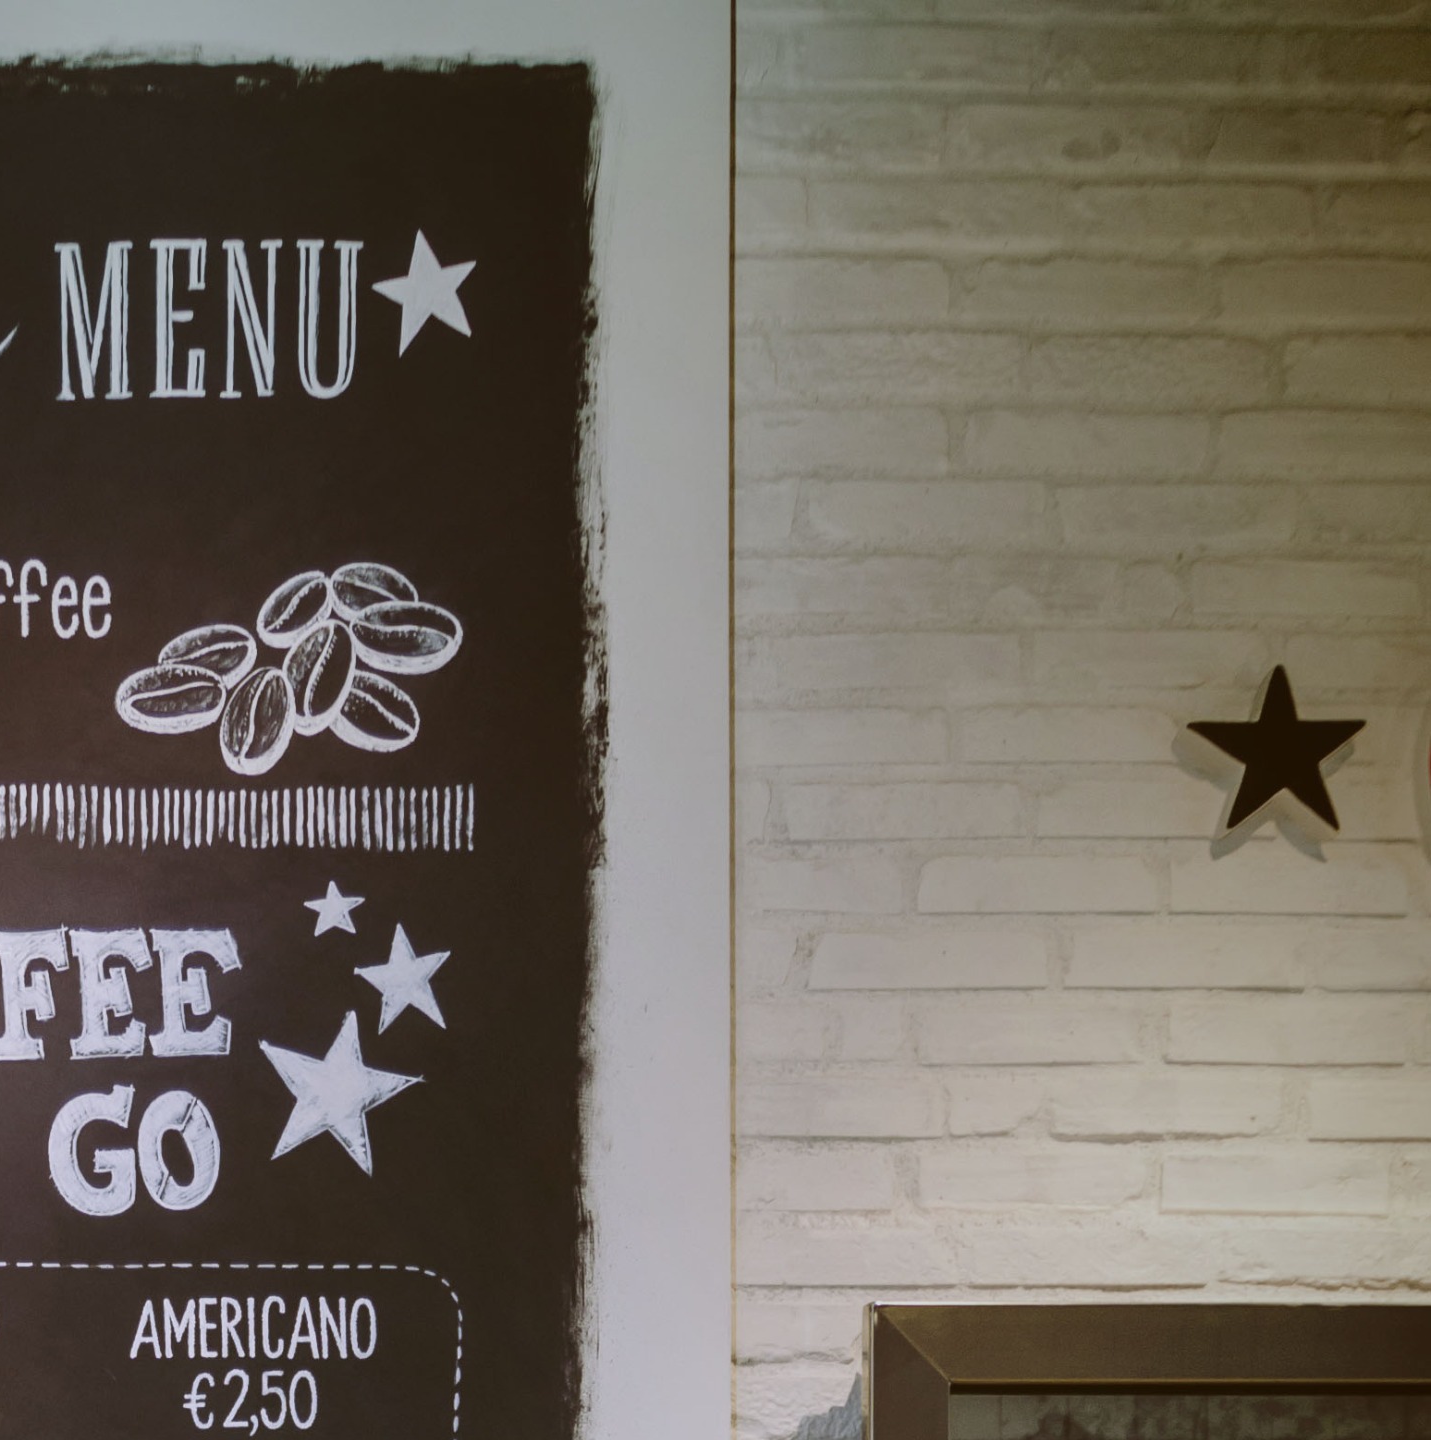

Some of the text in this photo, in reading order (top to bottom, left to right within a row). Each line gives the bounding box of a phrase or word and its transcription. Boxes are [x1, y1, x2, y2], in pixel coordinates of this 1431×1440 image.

[54, 238, 364, 401] MENU
[47, 1084, 221, 1217] GO
[129, 1295, 377, 1360] AMERICANO
